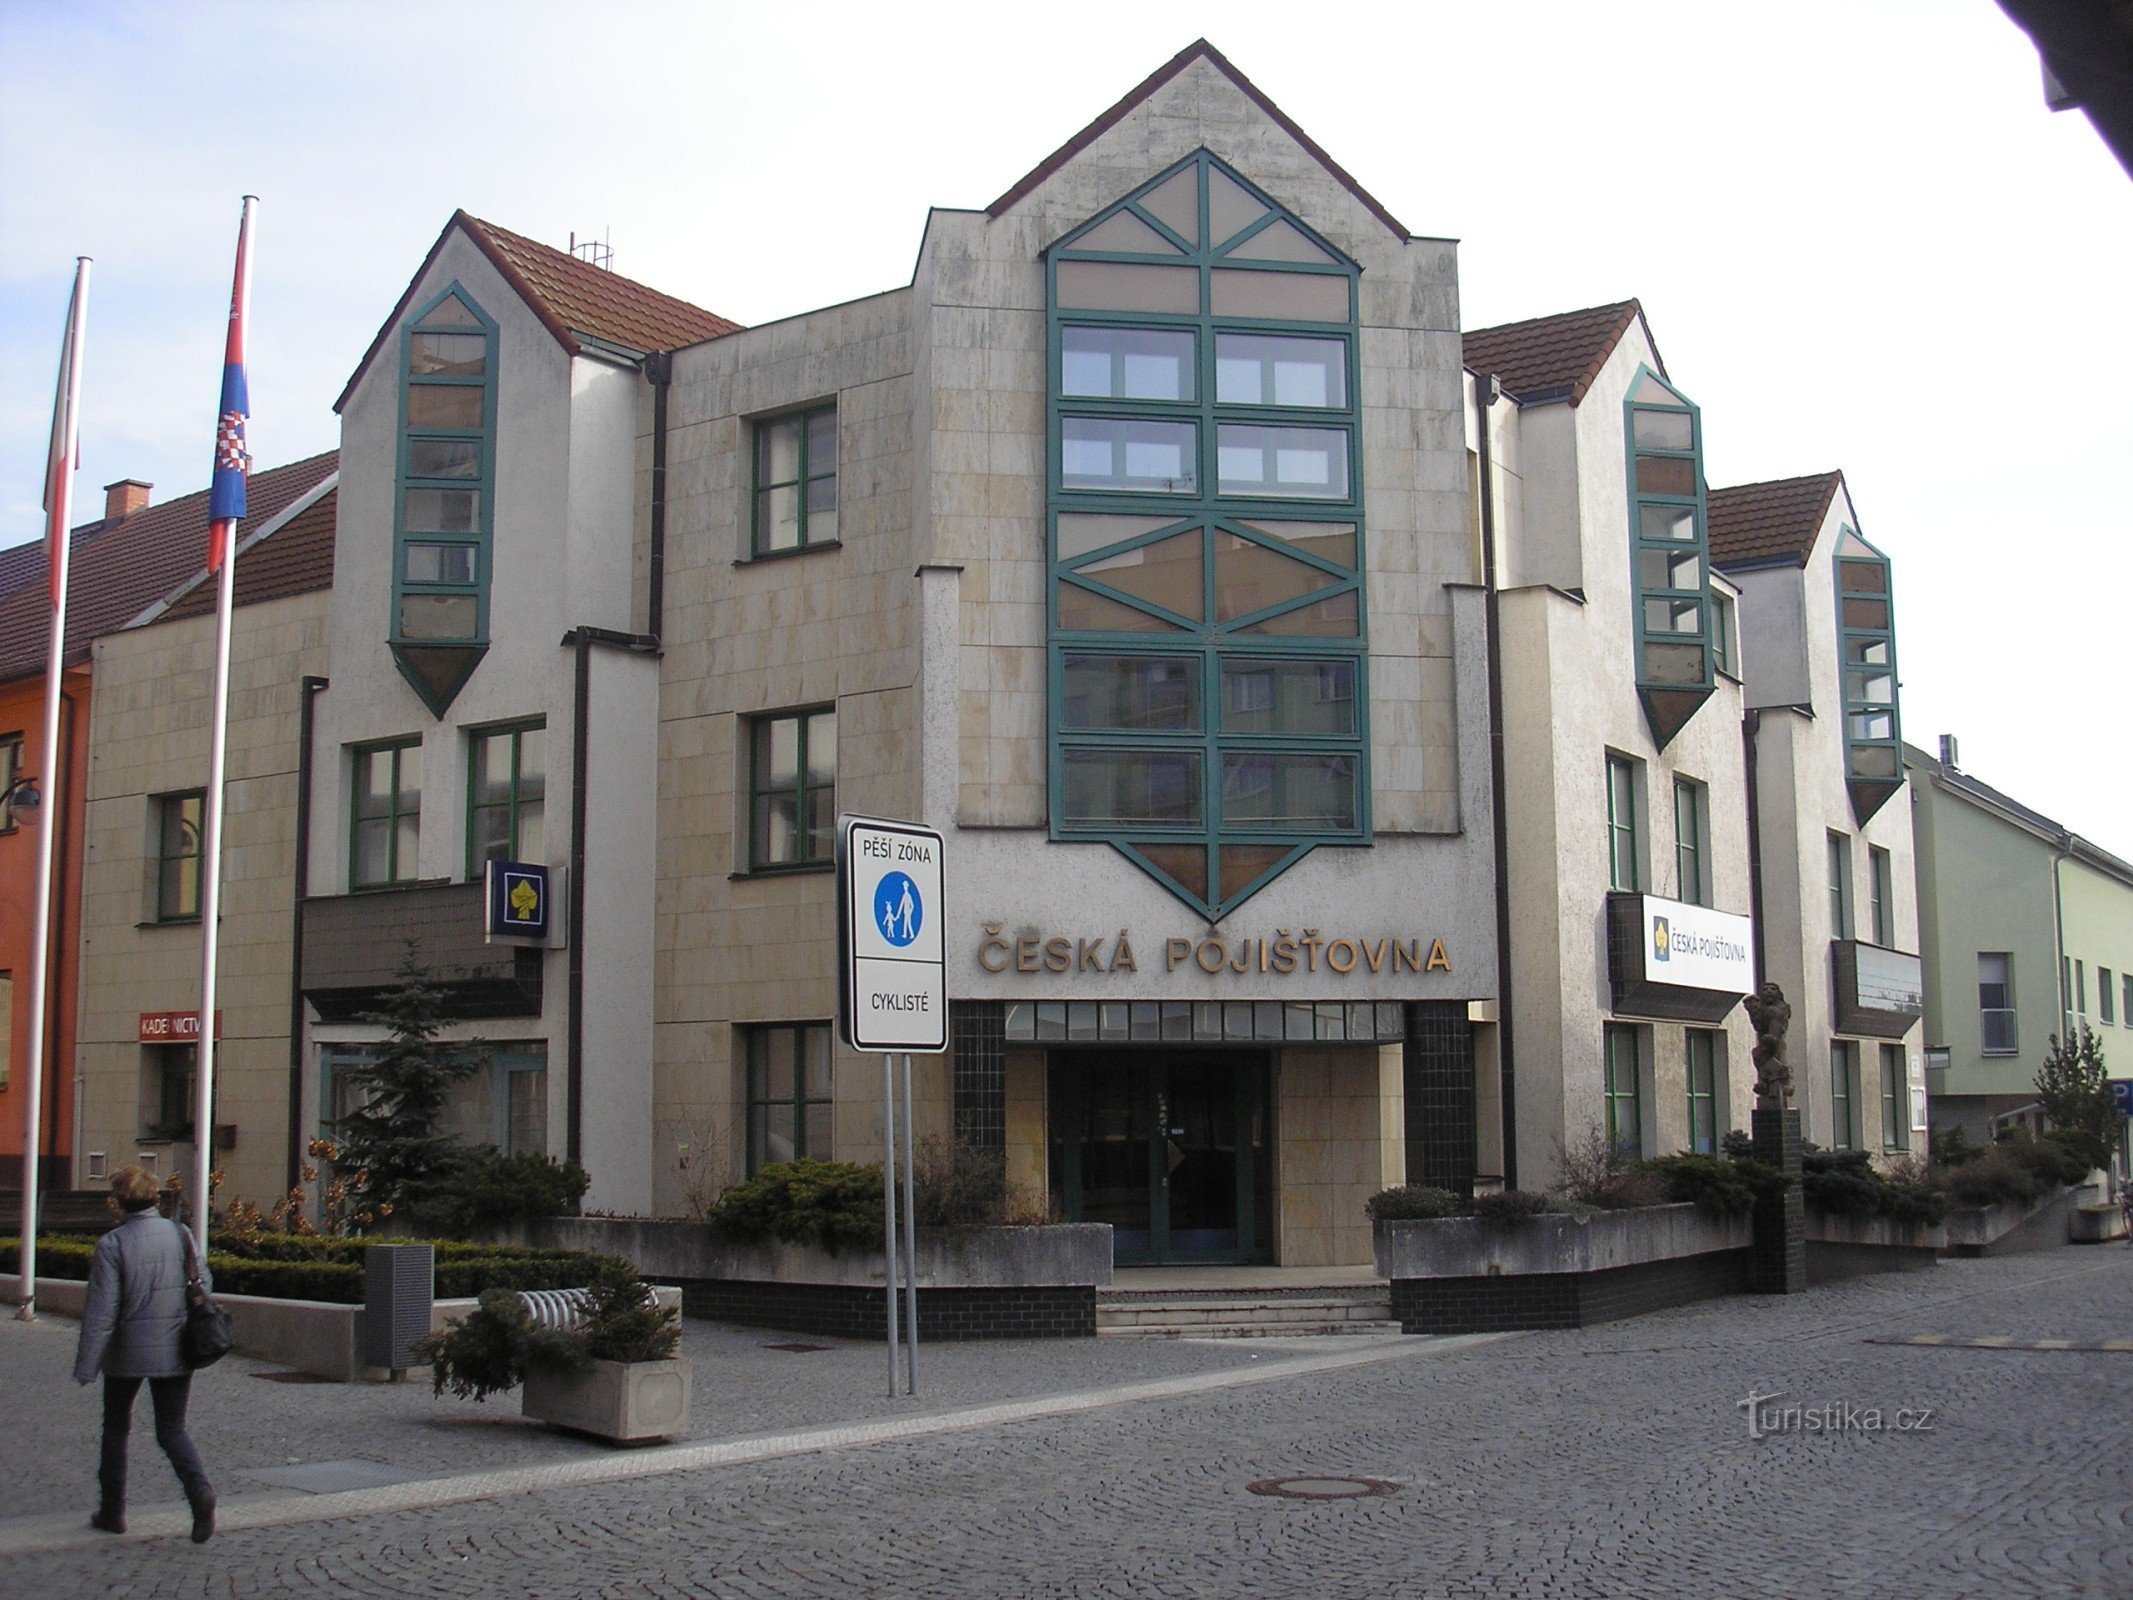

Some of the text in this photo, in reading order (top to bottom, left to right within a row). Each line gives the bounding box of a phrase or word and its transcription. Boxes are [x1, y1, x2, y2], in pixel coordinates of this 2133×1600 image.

[862, 835, 932, 864] PĚŠÍ ZÓNA
[978, 924, 1454, 974] ČESKÁ POJIŠŤOVNA
[1671, 927, 1697, 954] ČESKÁ
[871, 991, 929, 1012] CYKLISTÉ
[142, 1017, 204, 1035] KADENICTV
